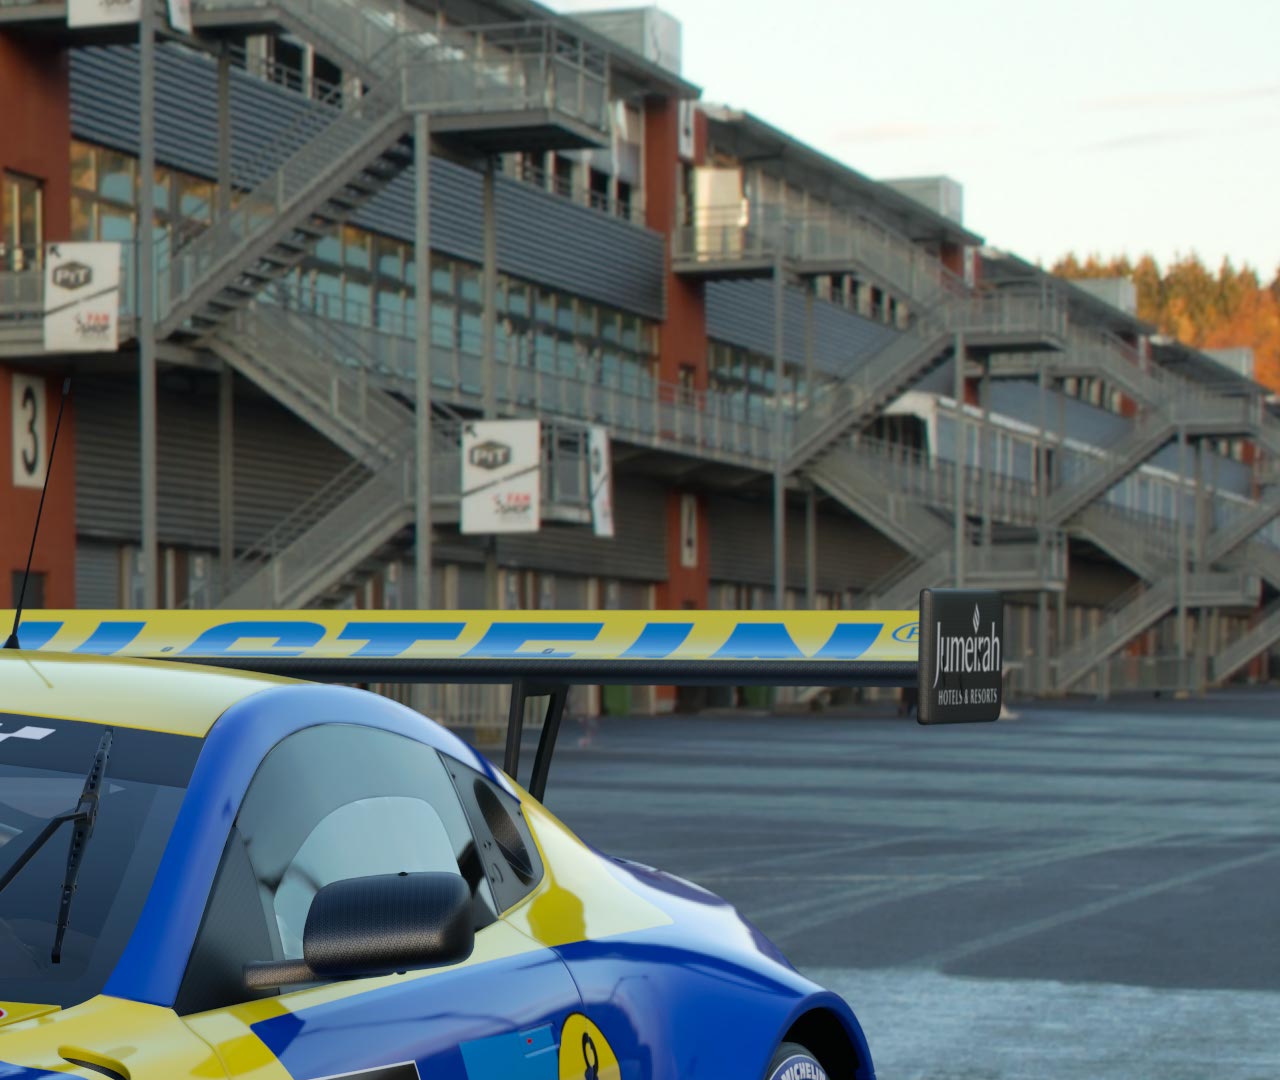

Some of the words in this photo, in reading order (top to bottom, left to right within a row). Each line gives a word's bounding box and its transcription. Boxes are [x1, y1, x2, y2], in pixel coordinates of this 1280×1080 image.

[22, 385, 38, 475] 3
[933, 621, 1000, 688] Jumeirah
[938, 689, 963, 705] HOTELS
[970, 688, 997, 703] RESORTS
